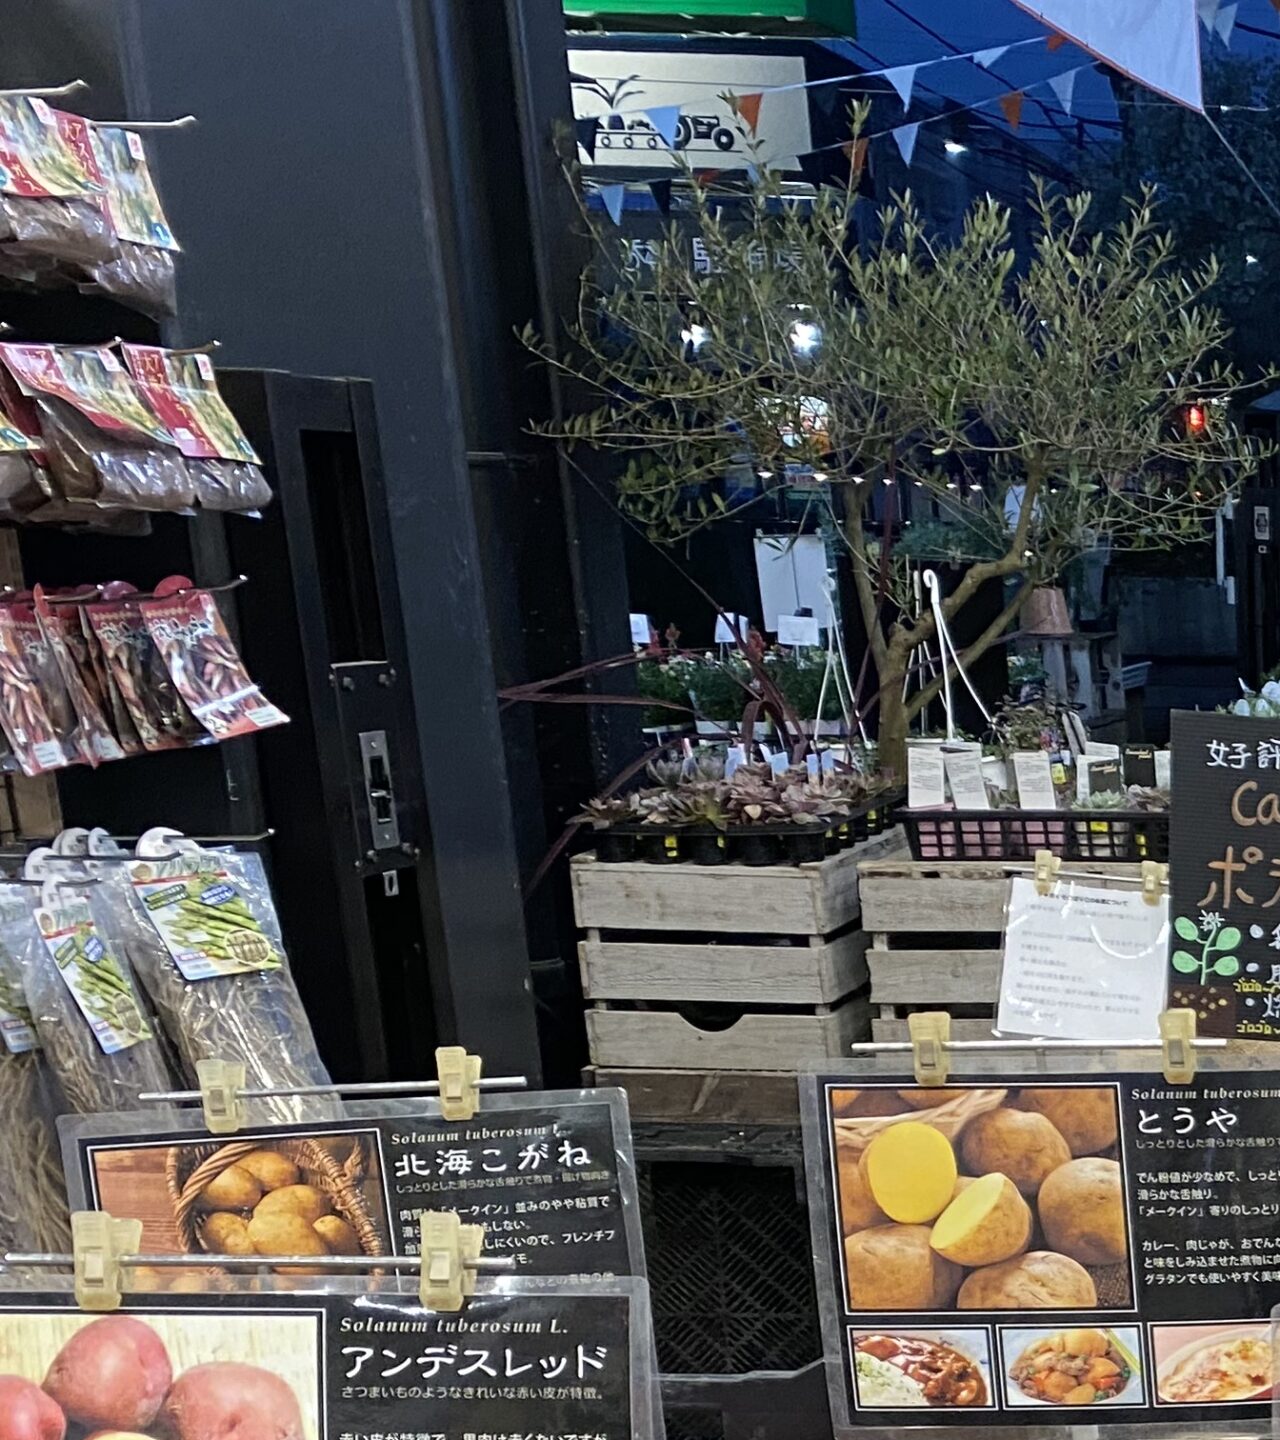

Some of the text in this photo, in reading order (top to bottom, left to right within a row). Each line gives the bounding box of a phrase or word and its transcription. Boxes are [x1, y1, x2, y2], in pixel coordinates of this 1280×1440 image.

[1131, 1089, 1197, 1100] Solanum
[1138, 1107, 1237, 1134] とうや
[391, 1132, 459, 1145] Solanum
[465, 1126, 546, 1141] tuberosum
[395, 1140, 591, 1177] 北海こがね
[1137, 1189, 1219, 1201] 滑らかな舌触り。
[340, 1317, 427, 1334] Solanum
[437, 1318, 541, 1334] tuberosum
[341, 1344, 607, 1379] アンデスレッド
